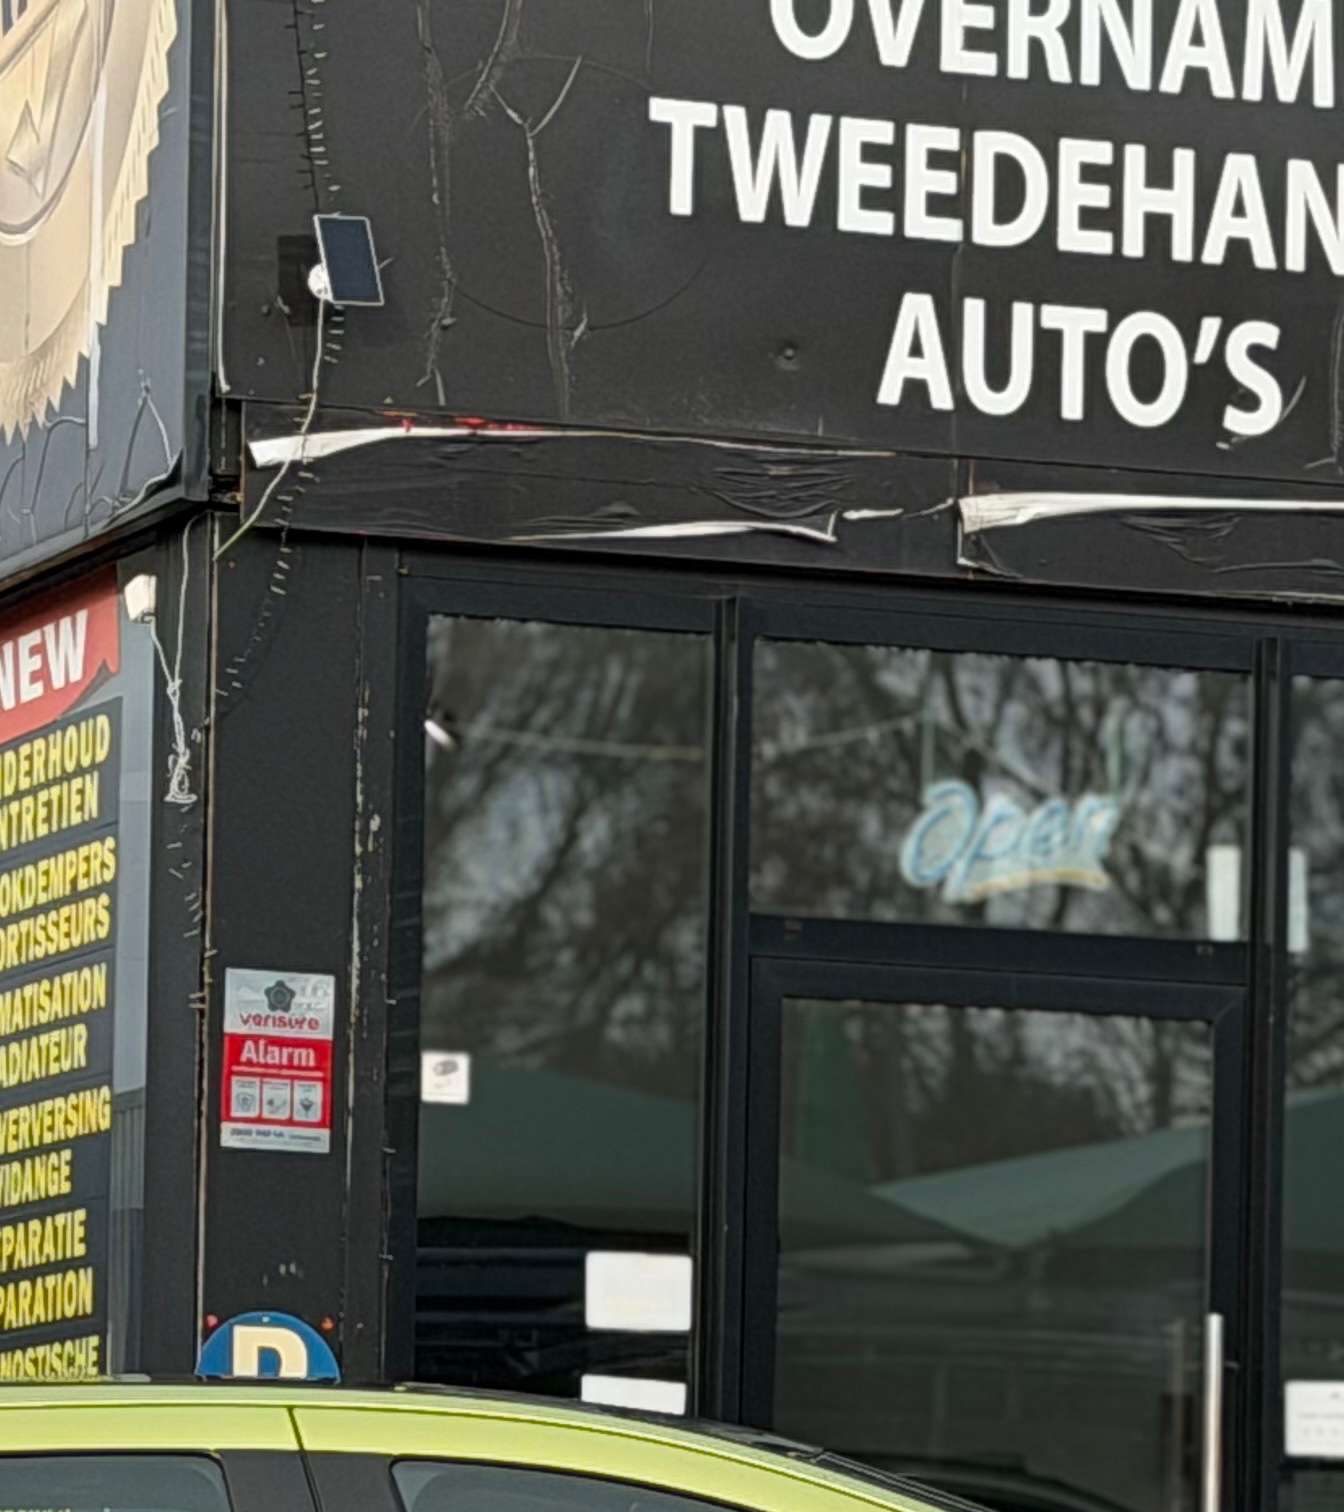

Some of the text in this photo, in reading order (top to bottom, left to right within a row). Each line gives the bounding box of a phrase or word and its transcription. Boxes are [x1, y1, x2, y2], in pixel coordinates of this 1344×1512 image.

[877, 293, 1283, 435] AUTO'S
[240, 1012, 320, 1031] verisure
[240, 1039, 316, 1067] Alarm
